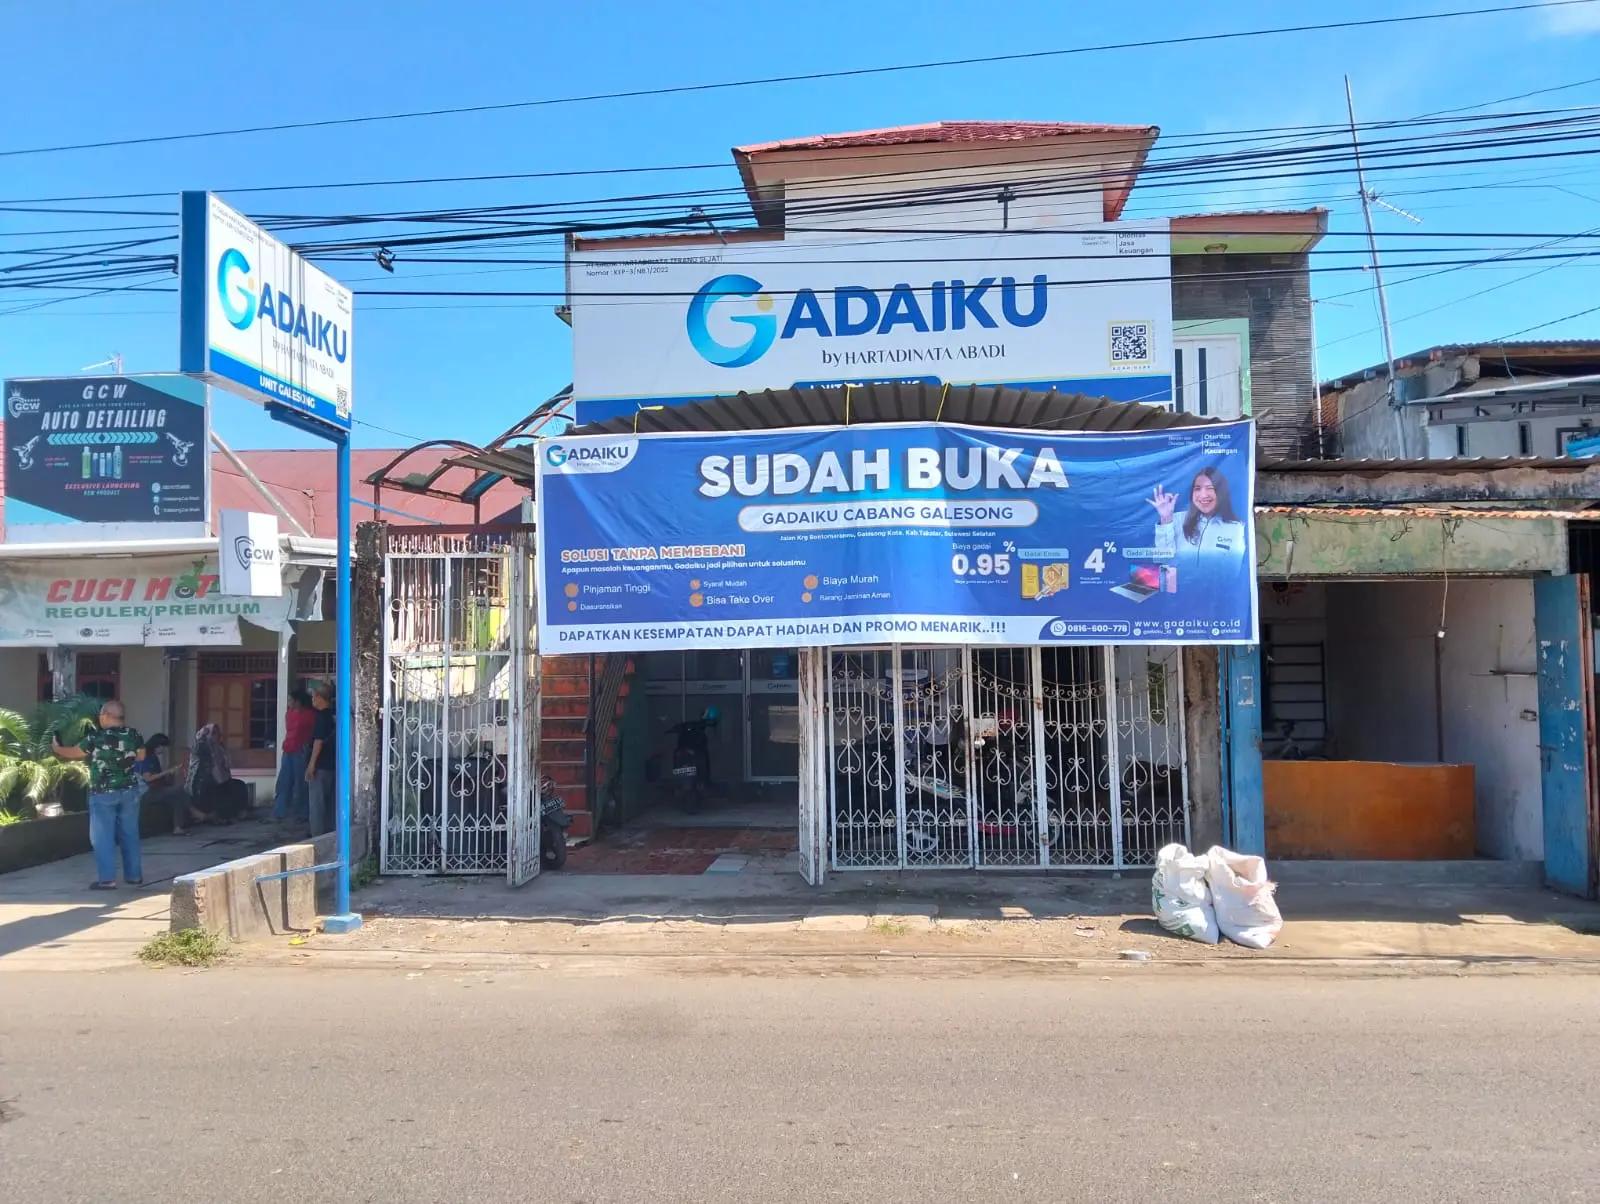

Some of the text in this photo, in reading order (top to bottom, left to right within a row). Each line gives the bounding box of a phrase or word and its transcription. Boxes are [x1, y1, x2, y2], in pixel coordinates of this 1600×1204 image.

[217, 247, 347, 364] GADAIKU
[687, 273, 1047, 369] GADAIKU
[822, 344, 1006, 367] by HARTADINATA ABADI
[82, 384, 128, 400] GCW
[260, 375, 316, 409] UNIT GALESONG
[15, 402, 41, 411] GCW
[41, 409, 168, 430] AUTO DETAILING
[547, 444, 629, 467] GADAIKU
[699, 447, 1070, 498] SUDAH BUKA
[762, 506, 1014, 525] GADAIKU CABANG GALESONG
[244, 548, 274, 560] GCW
[561, 544, 745, 563] SOLUSI TANPA MEMBEBANI
[562, 559, 806, 575] Apapun masalah keuanganmu, Gadaiku jadi pilihan untuk solusimu
[46, 577, 137, 603] CUCI
[583, 582, 651, 596] Pinjaman Tinggi
[823, 575, 879, 586] Biaya Murah
[706, 594, 774, 604] Bisa Take Over
[871, 592, 891, 600] Aman
[45, 602, 261, 619] REGULER/PREMIUM
[559, 620, 1006, 642] DAPATKAN KESEMPATAN DAPAT HADIAH DAN PROMO MENARIK..!!!
